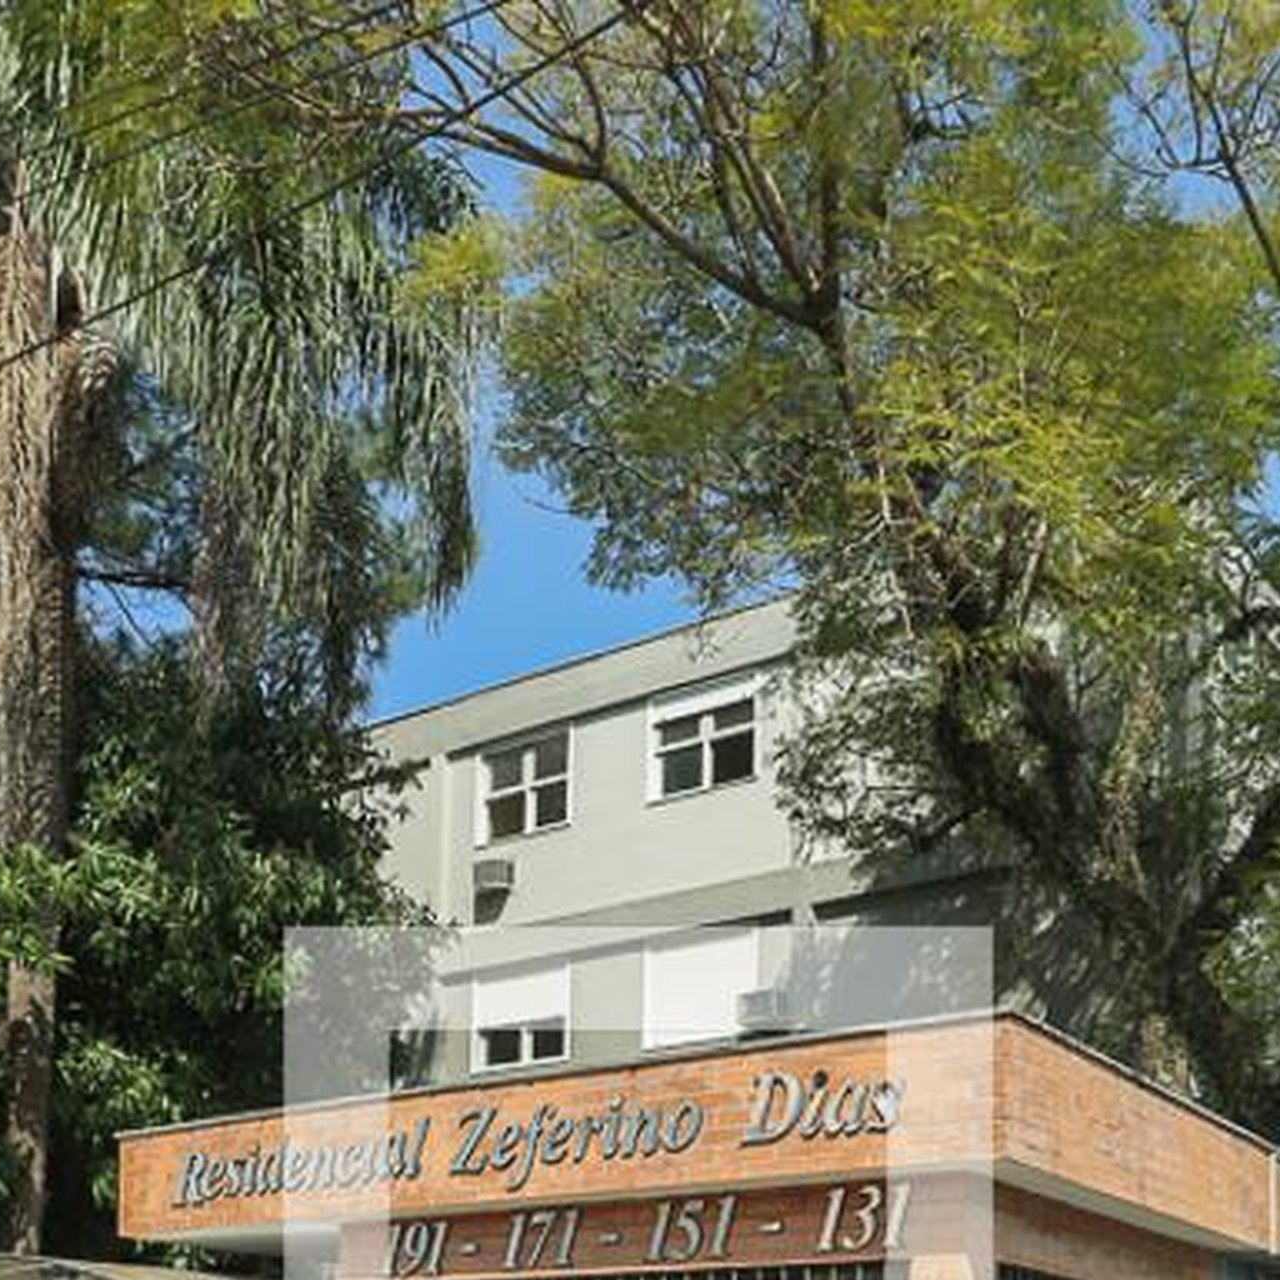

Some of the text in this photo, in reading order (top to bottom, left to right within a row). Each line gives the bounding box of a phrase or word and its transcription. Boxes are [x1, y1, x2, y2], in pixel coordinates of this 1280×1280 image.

[172, 1069, 906, 1207] Residencial Zeferino Dias
[385, 1219, 449, 1277] 191
[503, 1207, 581, 1269] 171
[645, 1194, 737, 1261] 151
[817, 1182, 911, 1252] 131
